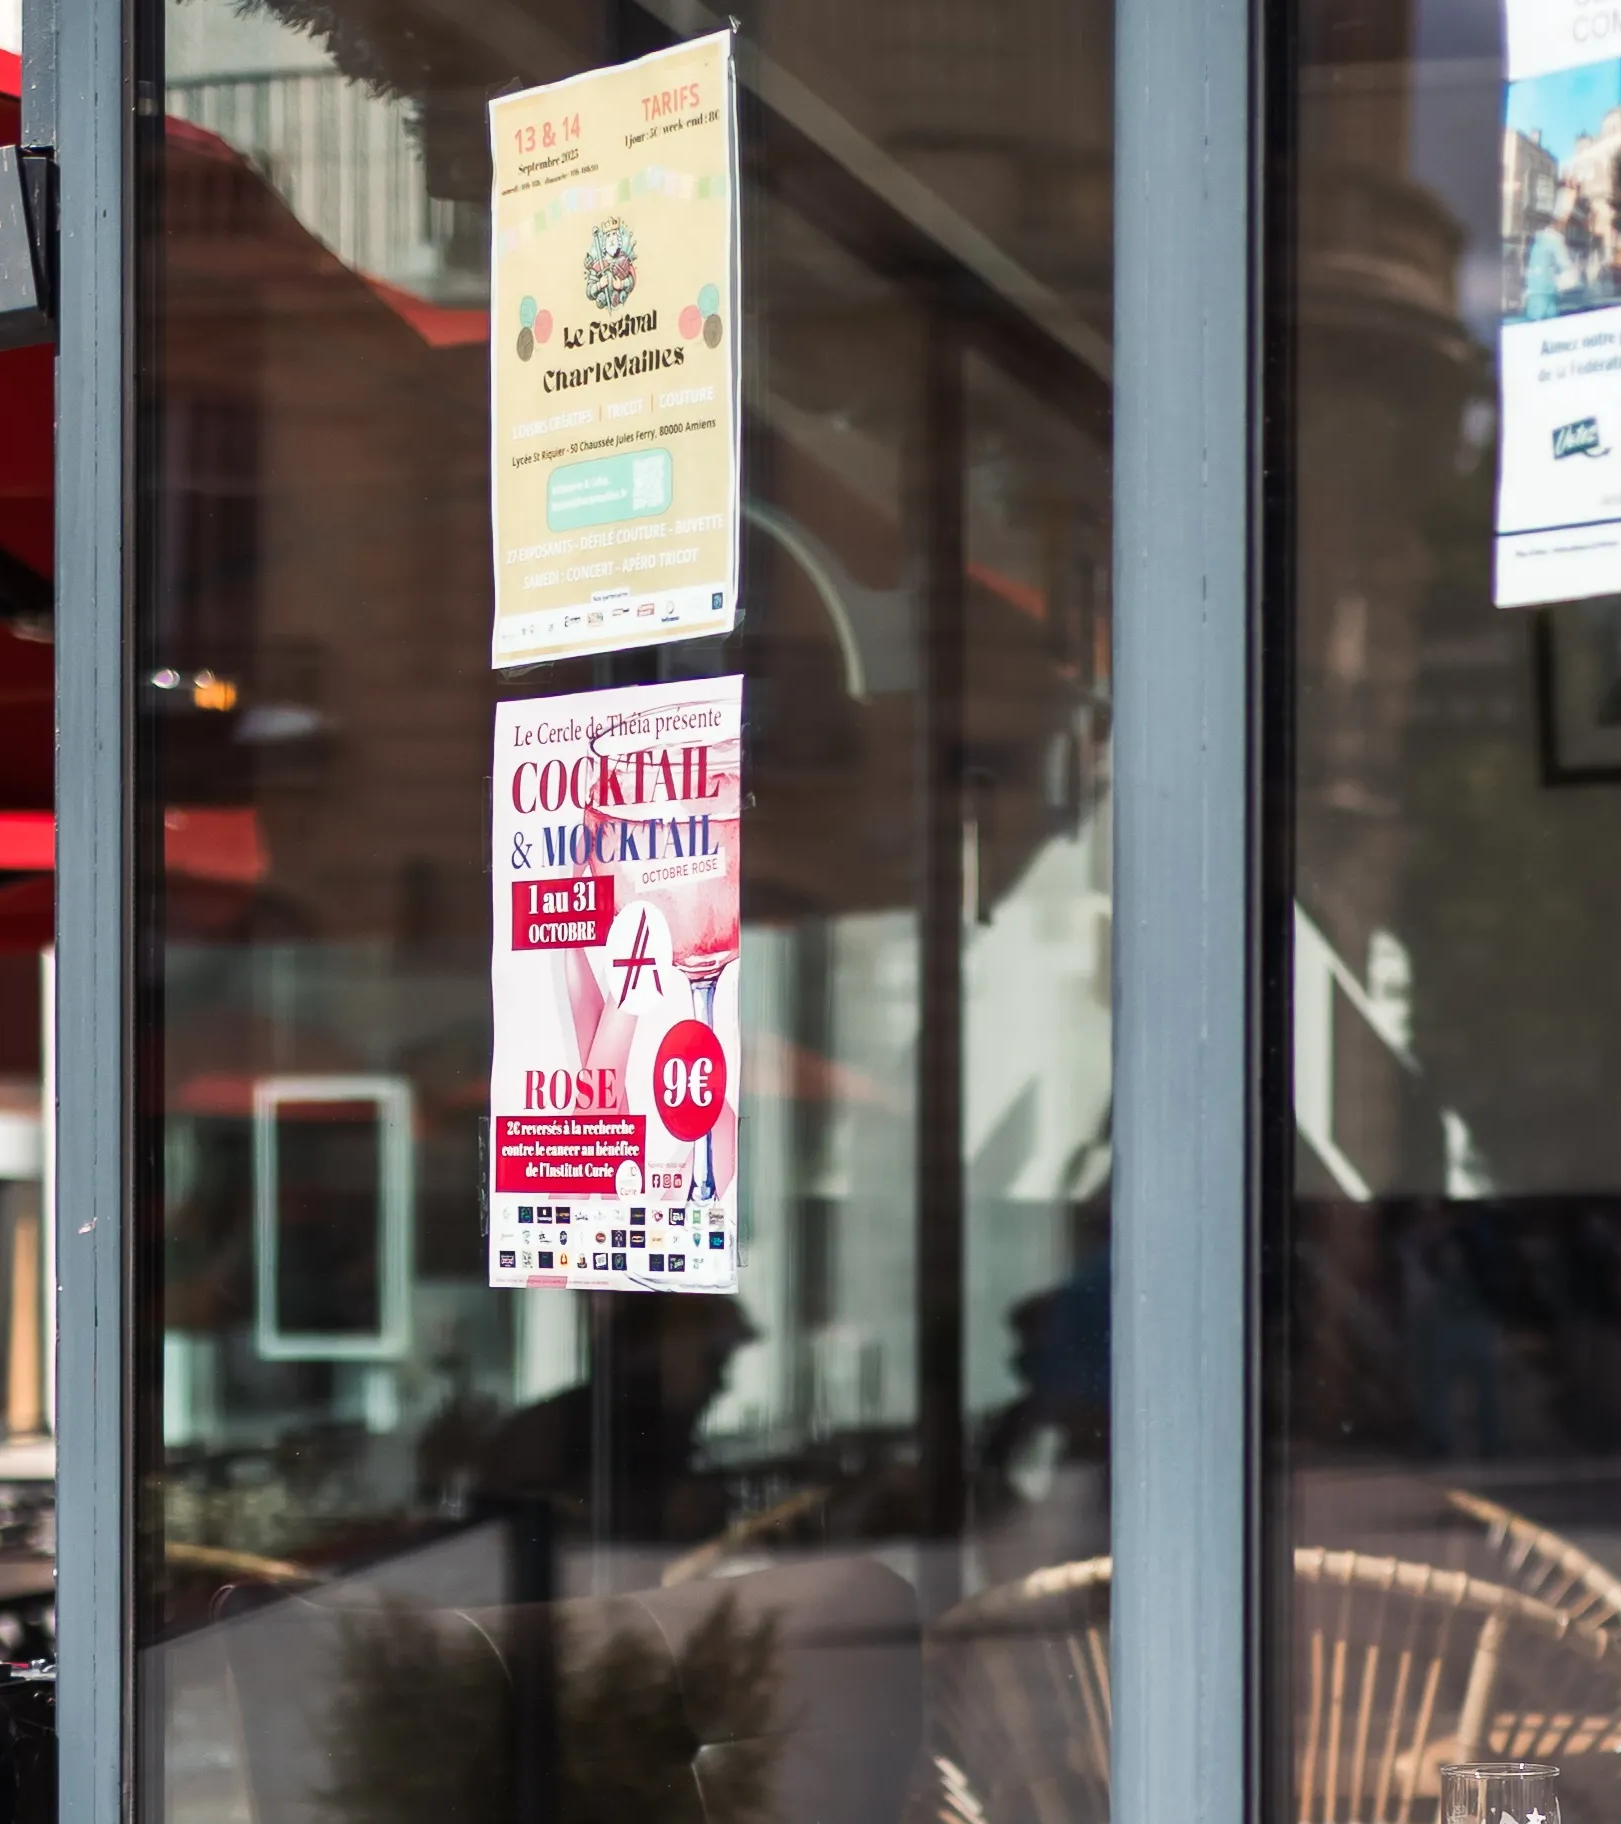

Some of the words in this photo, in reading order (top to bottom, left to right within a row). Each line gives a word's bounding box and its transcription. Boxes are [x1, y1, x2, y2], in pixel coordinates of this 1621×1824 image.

[642, 83, 700, 121] TARIFS
[514, 126, 536, 154] 13
[542, 122, 557, 148] &
[562, 113, 581, 141] 14
[518, 157, 560, 176] Septembre
[564, 327, 585, 349] Le
[589, 310, 657, 345] Festival
[1583, 333, 1616, 349] notre
[543, 346, 685, 394] CharleMailles
[606, 398, 644, 420] TRICOT
[659, 387, 714, 408] COUTURE
[512, 451, 532, 468] Lycée
[541, 445, 565, 462] Riquier
[570, 443, 579, 455] 50
[579, 437, 614, 453] Chaussée
[615, 430, 634, 450] Jules
[635, 428, 657, 446] Ferry,
[659, 423, 683, 438] 80000
[685, 417, 716, 432] Amiens
[506, 551, 518, 566] 27
[518, 539, 574, 563] EXPOSANTS
[581, 526, 615, 551] DÉFILÉ
[616, 522, 667, 545] COUTURE
[674, 513, 725, 536] BUVETTE
[523, 571, 560, 591] SAMEDI
[566, 561, 614, 583] CONCERT
[622, 552, 656, 575] APÉRO
[659, 546, 700, 568] TRICOT
[514, 725, 532, 748] Le
[537, 718, 581, 746] Cercle
[586, 715, 603, 739] de
[607, 710, 650, 737] Théia
[655, 706, 722, 741] présente
[512, 745, 721, 814] COCKTAIL
[511, 831, 532, 870] &
[541, 814, 720, 868] MOCKTAIL
[642, 865, 689, 885] OCTOBRE
[692, 858, 718, 875] ROSE
[528, 884, 539, 915] 1
[543, 888, 569, 913] au
[573, 880, 596, 912] 31
[529, 921, 596, 944] OCTOBRE
[524, 1068, 618, 1111] ROSE
[662, 1057, 714, 1108] 9€
[522, 1120, 562, 1136] reversés
[563, 1120, 570, 1135] à
[571, 1119, 582, 1135] la
[583, 1119, 635, 1135] recherche
[501, 1143, 535, 1157] contre
[535, 1141, 546, 1156] le
[546, 1145, 581, 1157] cancer
[581, 1145, 595, 1156] au
[595, 1140, 640, 1156] bénéfice
[525, 1162, 538, 1178] de
[539, 1162, 583, 1178] l'Institut
[584, 1162, 614, 1178] Curie
